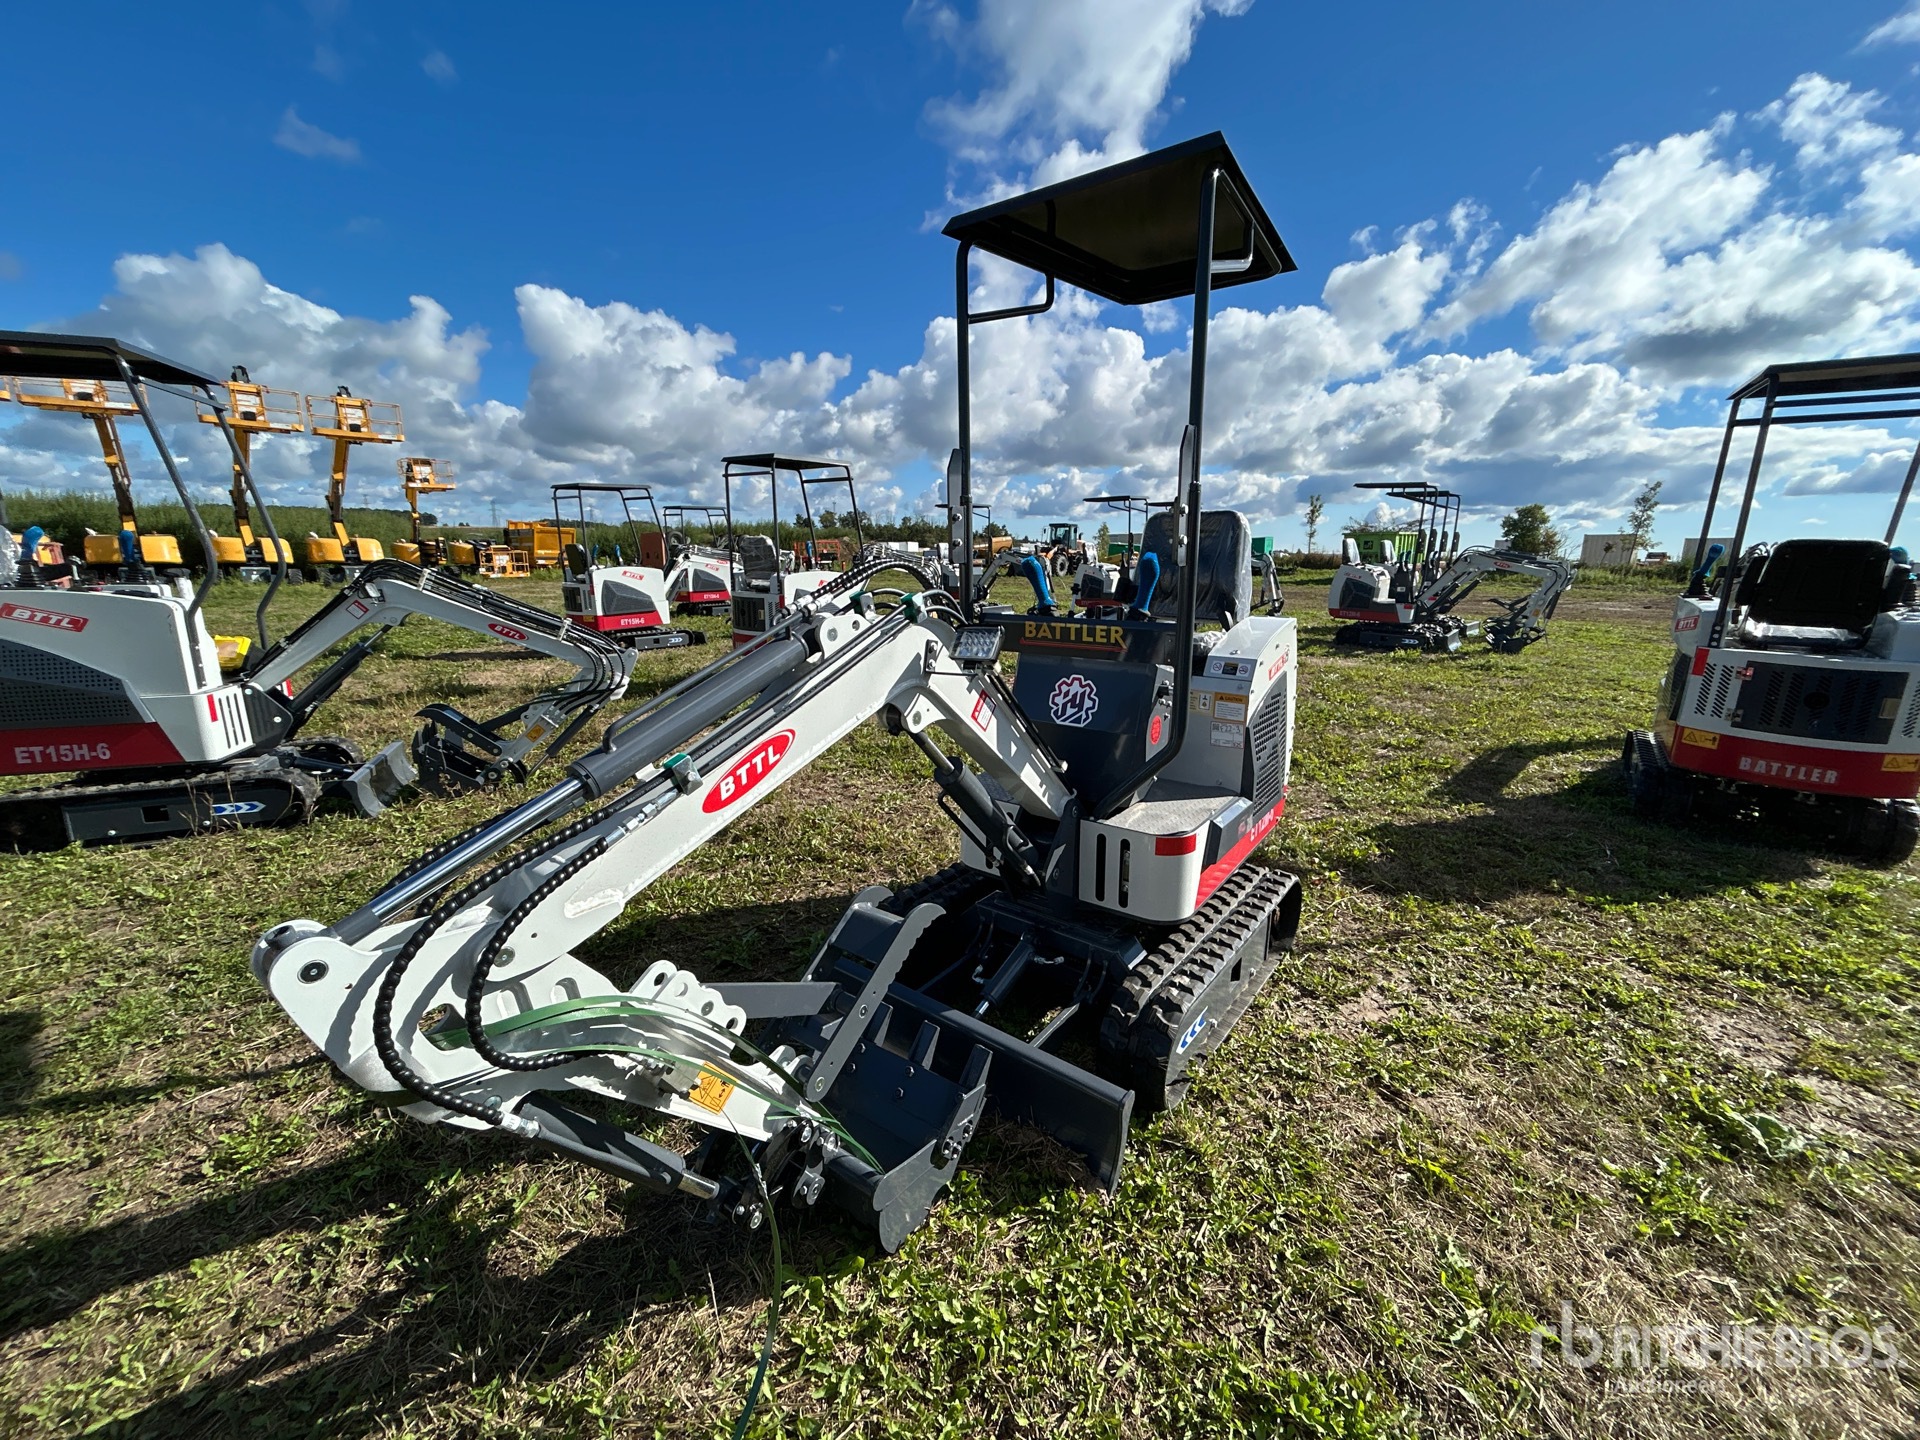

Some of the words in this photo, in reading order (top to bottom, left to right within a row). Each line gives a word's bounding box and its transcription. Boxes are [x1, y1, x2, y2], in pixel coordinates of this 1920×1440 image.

[12, 608, 74, 628] BTTL
[620, 617, 645, 627] ET15H-6
[1677, 619, 1695, 630] BTTL
[494, 625, 520, 640] BTTL
[1024, 620, 1128, 650] BATTLER
[14, 742, 111, 765] ET15H-6
[719, 744, 781, 802] BTTL
[1738, 757, 1838, 784] BATTLER
